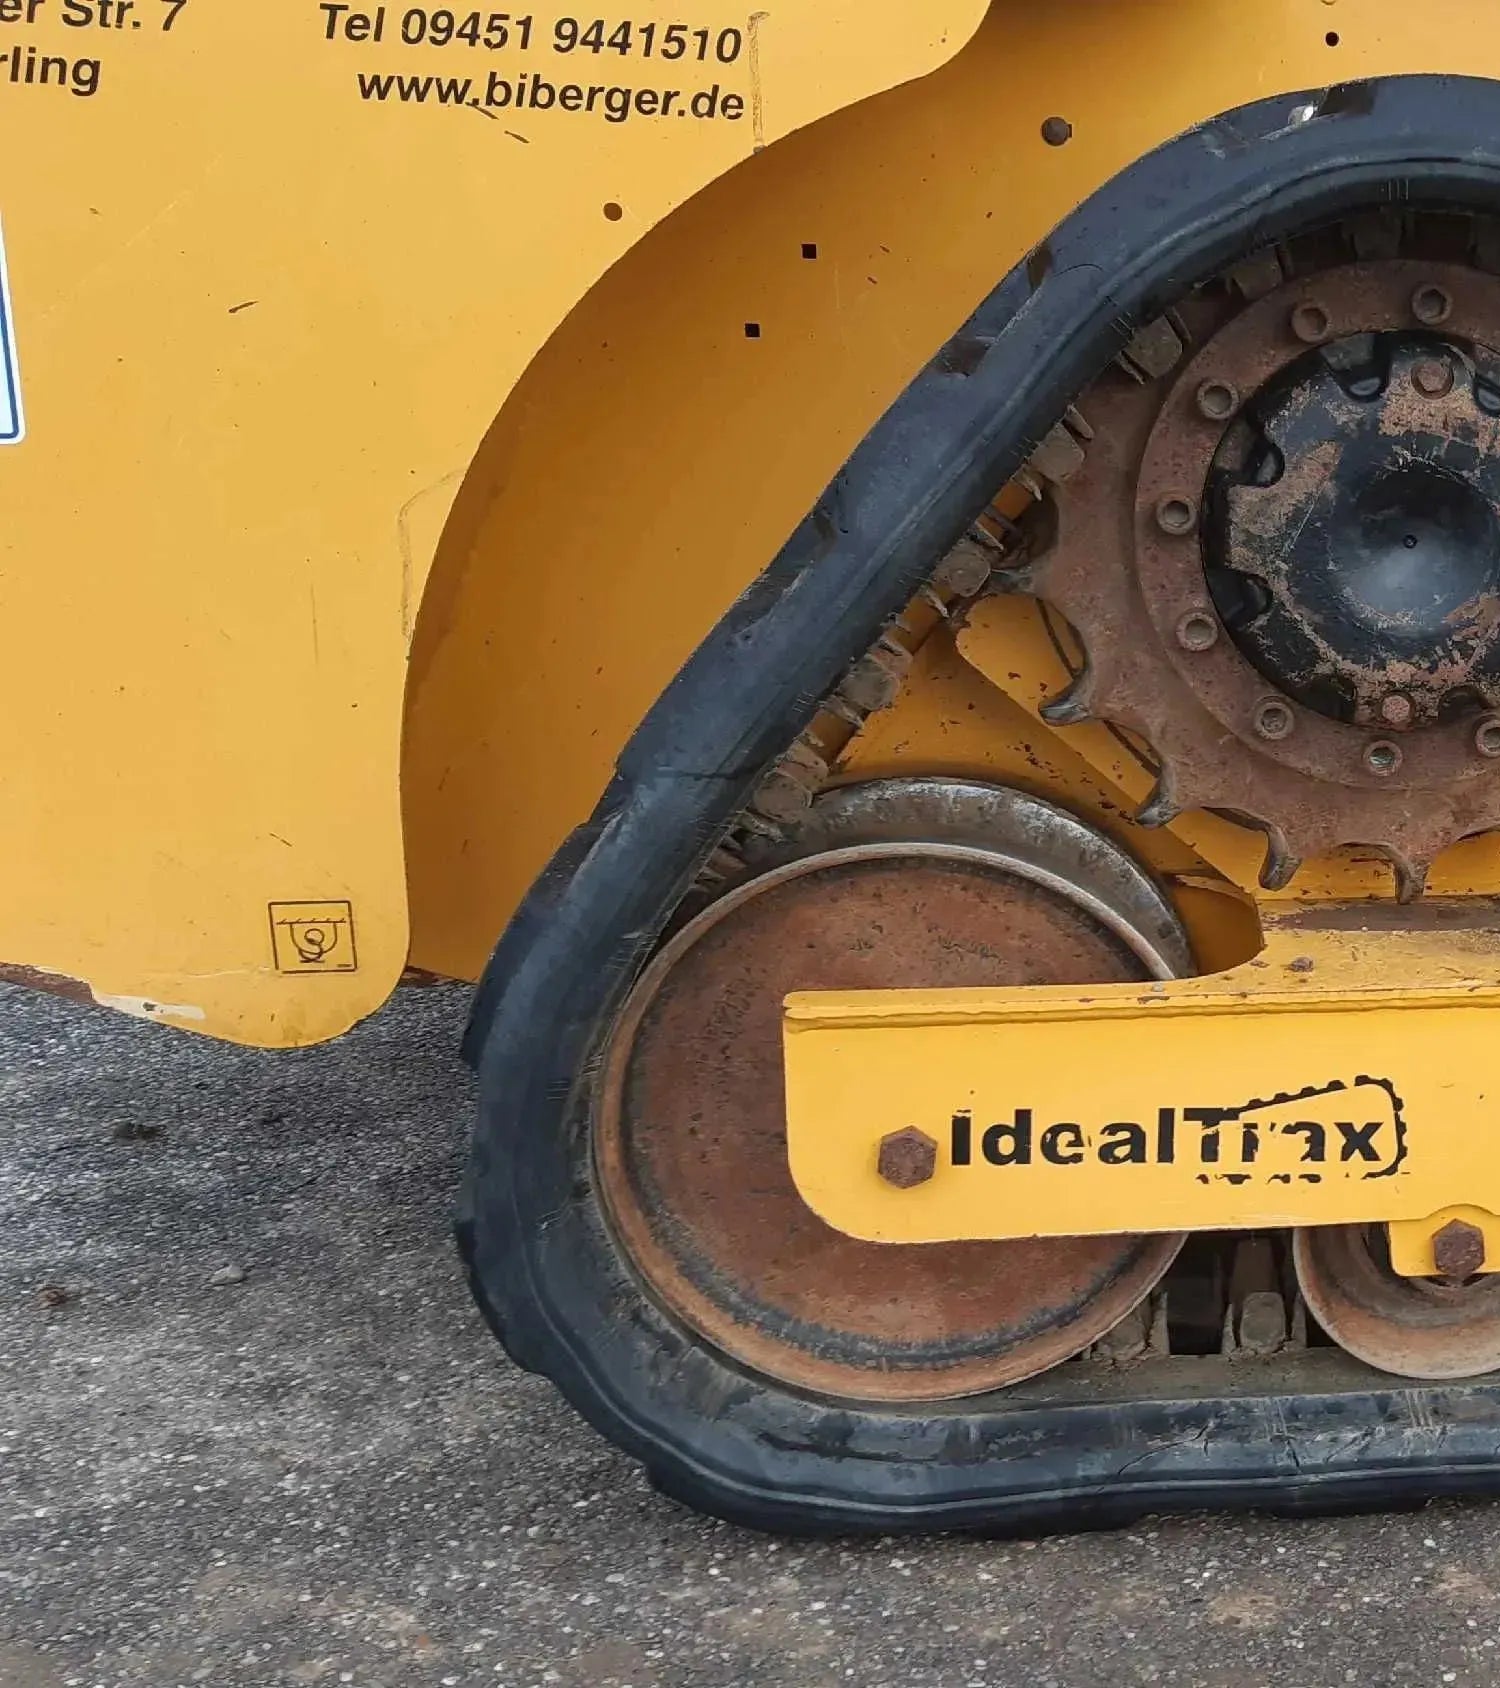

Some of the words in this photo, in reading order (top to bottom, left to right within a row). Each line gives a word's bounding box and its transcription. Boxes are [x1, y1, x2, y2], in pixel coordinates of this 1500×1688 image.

[61, 0, 141, 29] Str.
[161, 0, 187, 32] 7
[319, 3, 385, 42] Tel
[401, 8, 533, 50] 09451
[553, 17, 742, 64] 9441510
[357, 71, 744, 123] www.biberger.de
